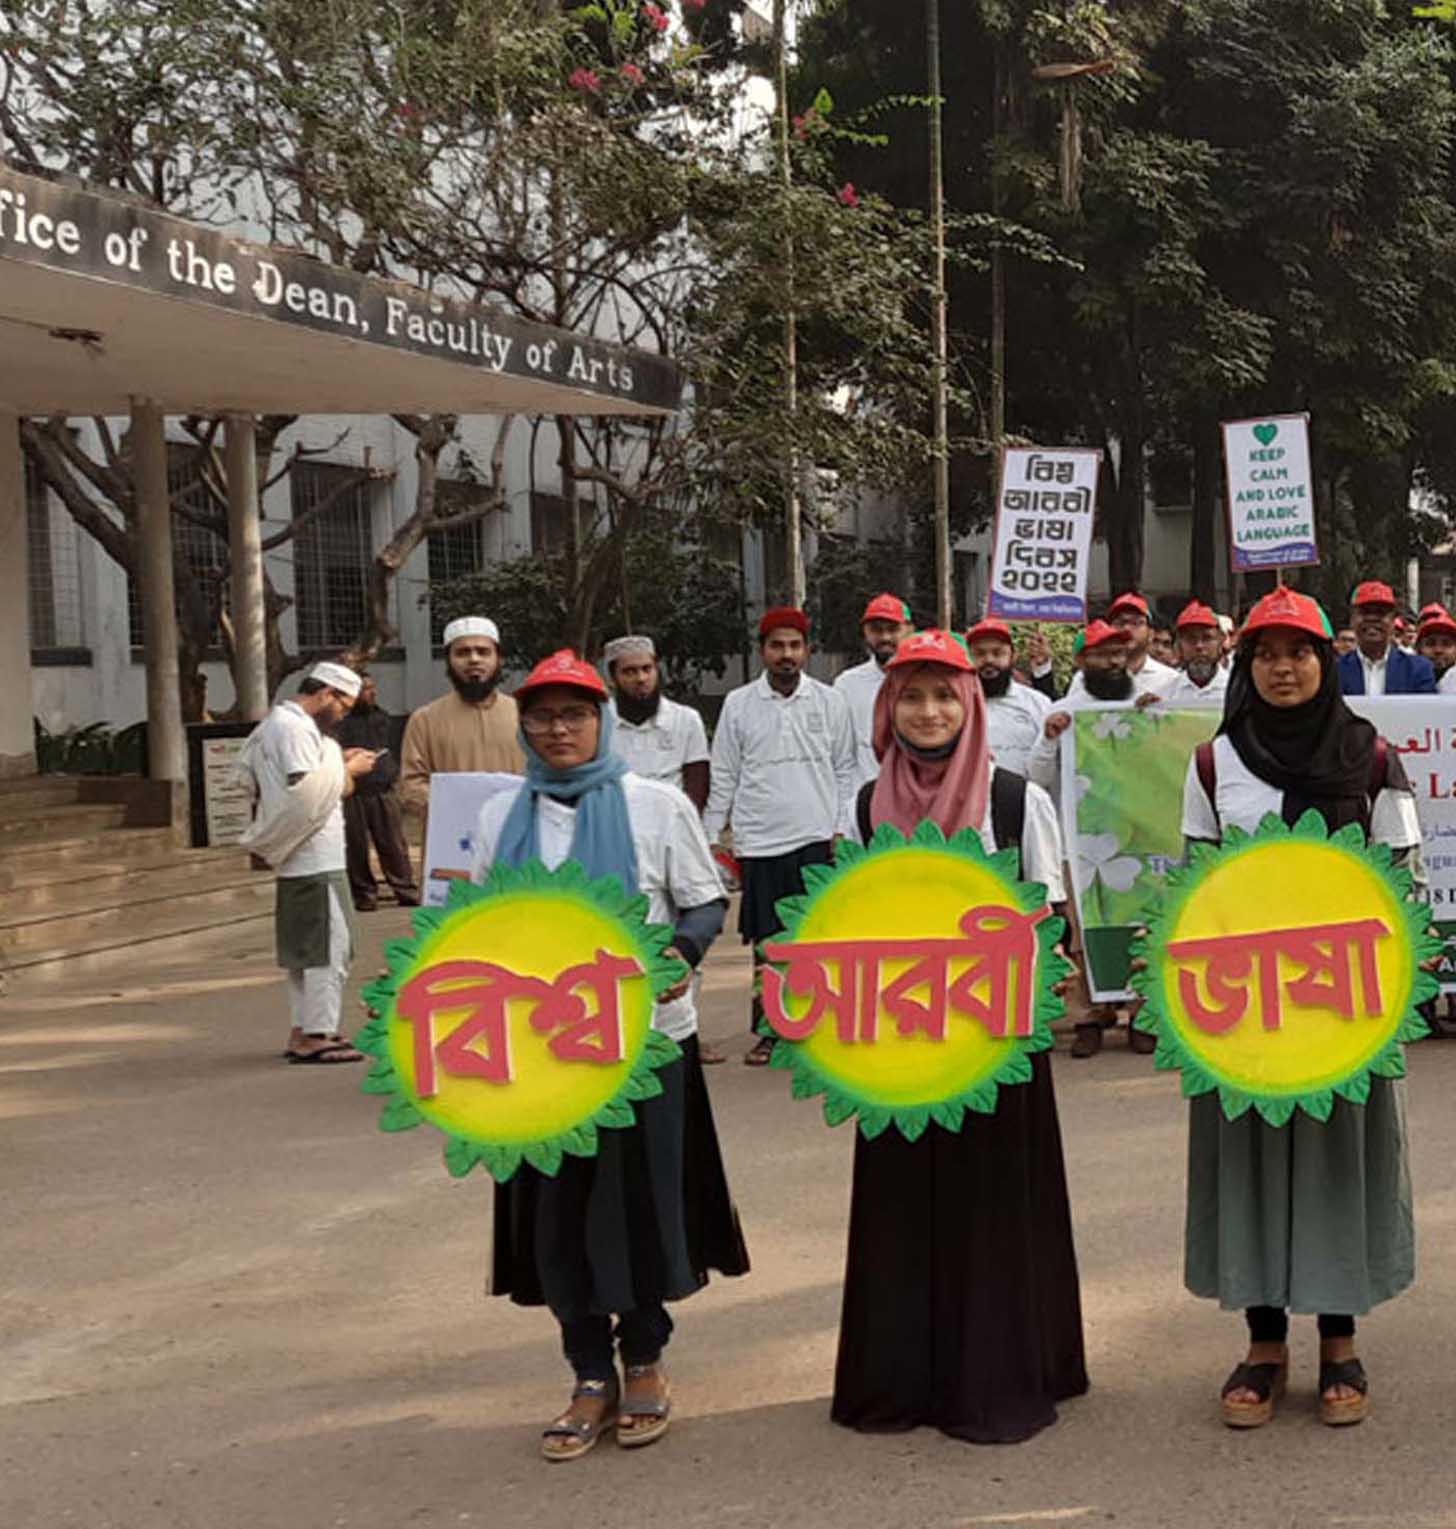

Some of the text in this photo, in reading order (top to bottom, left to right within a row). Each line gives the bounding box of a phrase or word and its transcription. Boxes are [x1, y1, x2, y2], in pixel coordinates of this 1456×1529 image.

[0, 190, 634, 391] fice of the Dean, Faculty of Arts
[1249, 447, 1285, 462] KEEP
[1025, 454, 1074, 484] বিশ্ব
[1250, 467, 1288, 482] CALM
[1003, 486, 1092, 514] আরবী
[1236, 484, 1305, 502] AND LOVE
[1247, 505, 1298, 521] ARABIC
[1015, 518, 1074, 540] ভাষা
[1237, 523, 1310, 542] LANGUAGE
[1005, 540, 1077, 569] দিবস
[1000, 569, 1077, 593] ২০২২
[762, 905, 1051, 1043] আরবী
[1166, 918, 1390, 1034] ভাষা
[398, 949, 644, 1097] বিশ্ব
